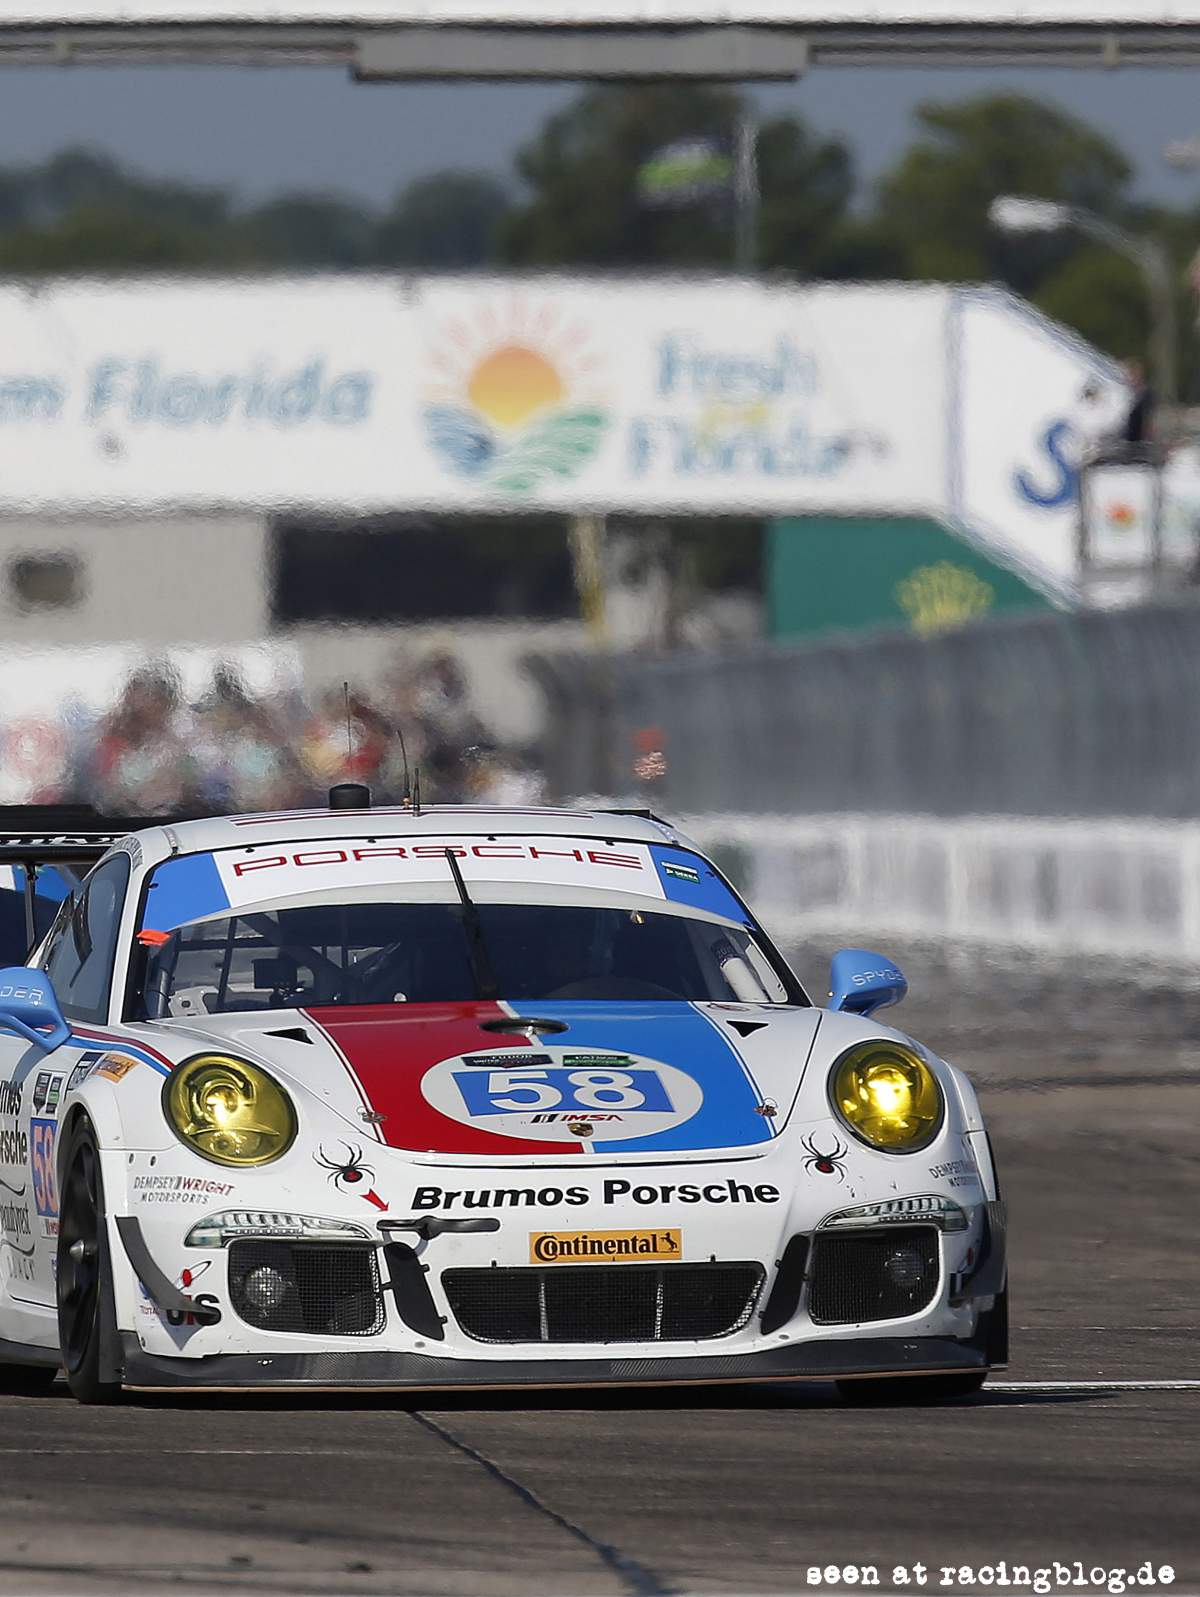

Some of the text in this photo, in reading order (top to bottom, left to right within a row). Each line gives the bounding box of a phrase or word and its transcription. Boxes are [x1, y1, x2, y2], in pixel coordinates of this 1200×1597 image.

[88, 350, 374, 426] Florida
[233, 844, 643, 877] PORSCHE
[488, 1070, 646, 1111] 58
[560, 1113, 624, 1122] IMSA
[411, 1179, 780, 1210] Brumos Porsche
[534, 1233, 658, 1262] Continental
